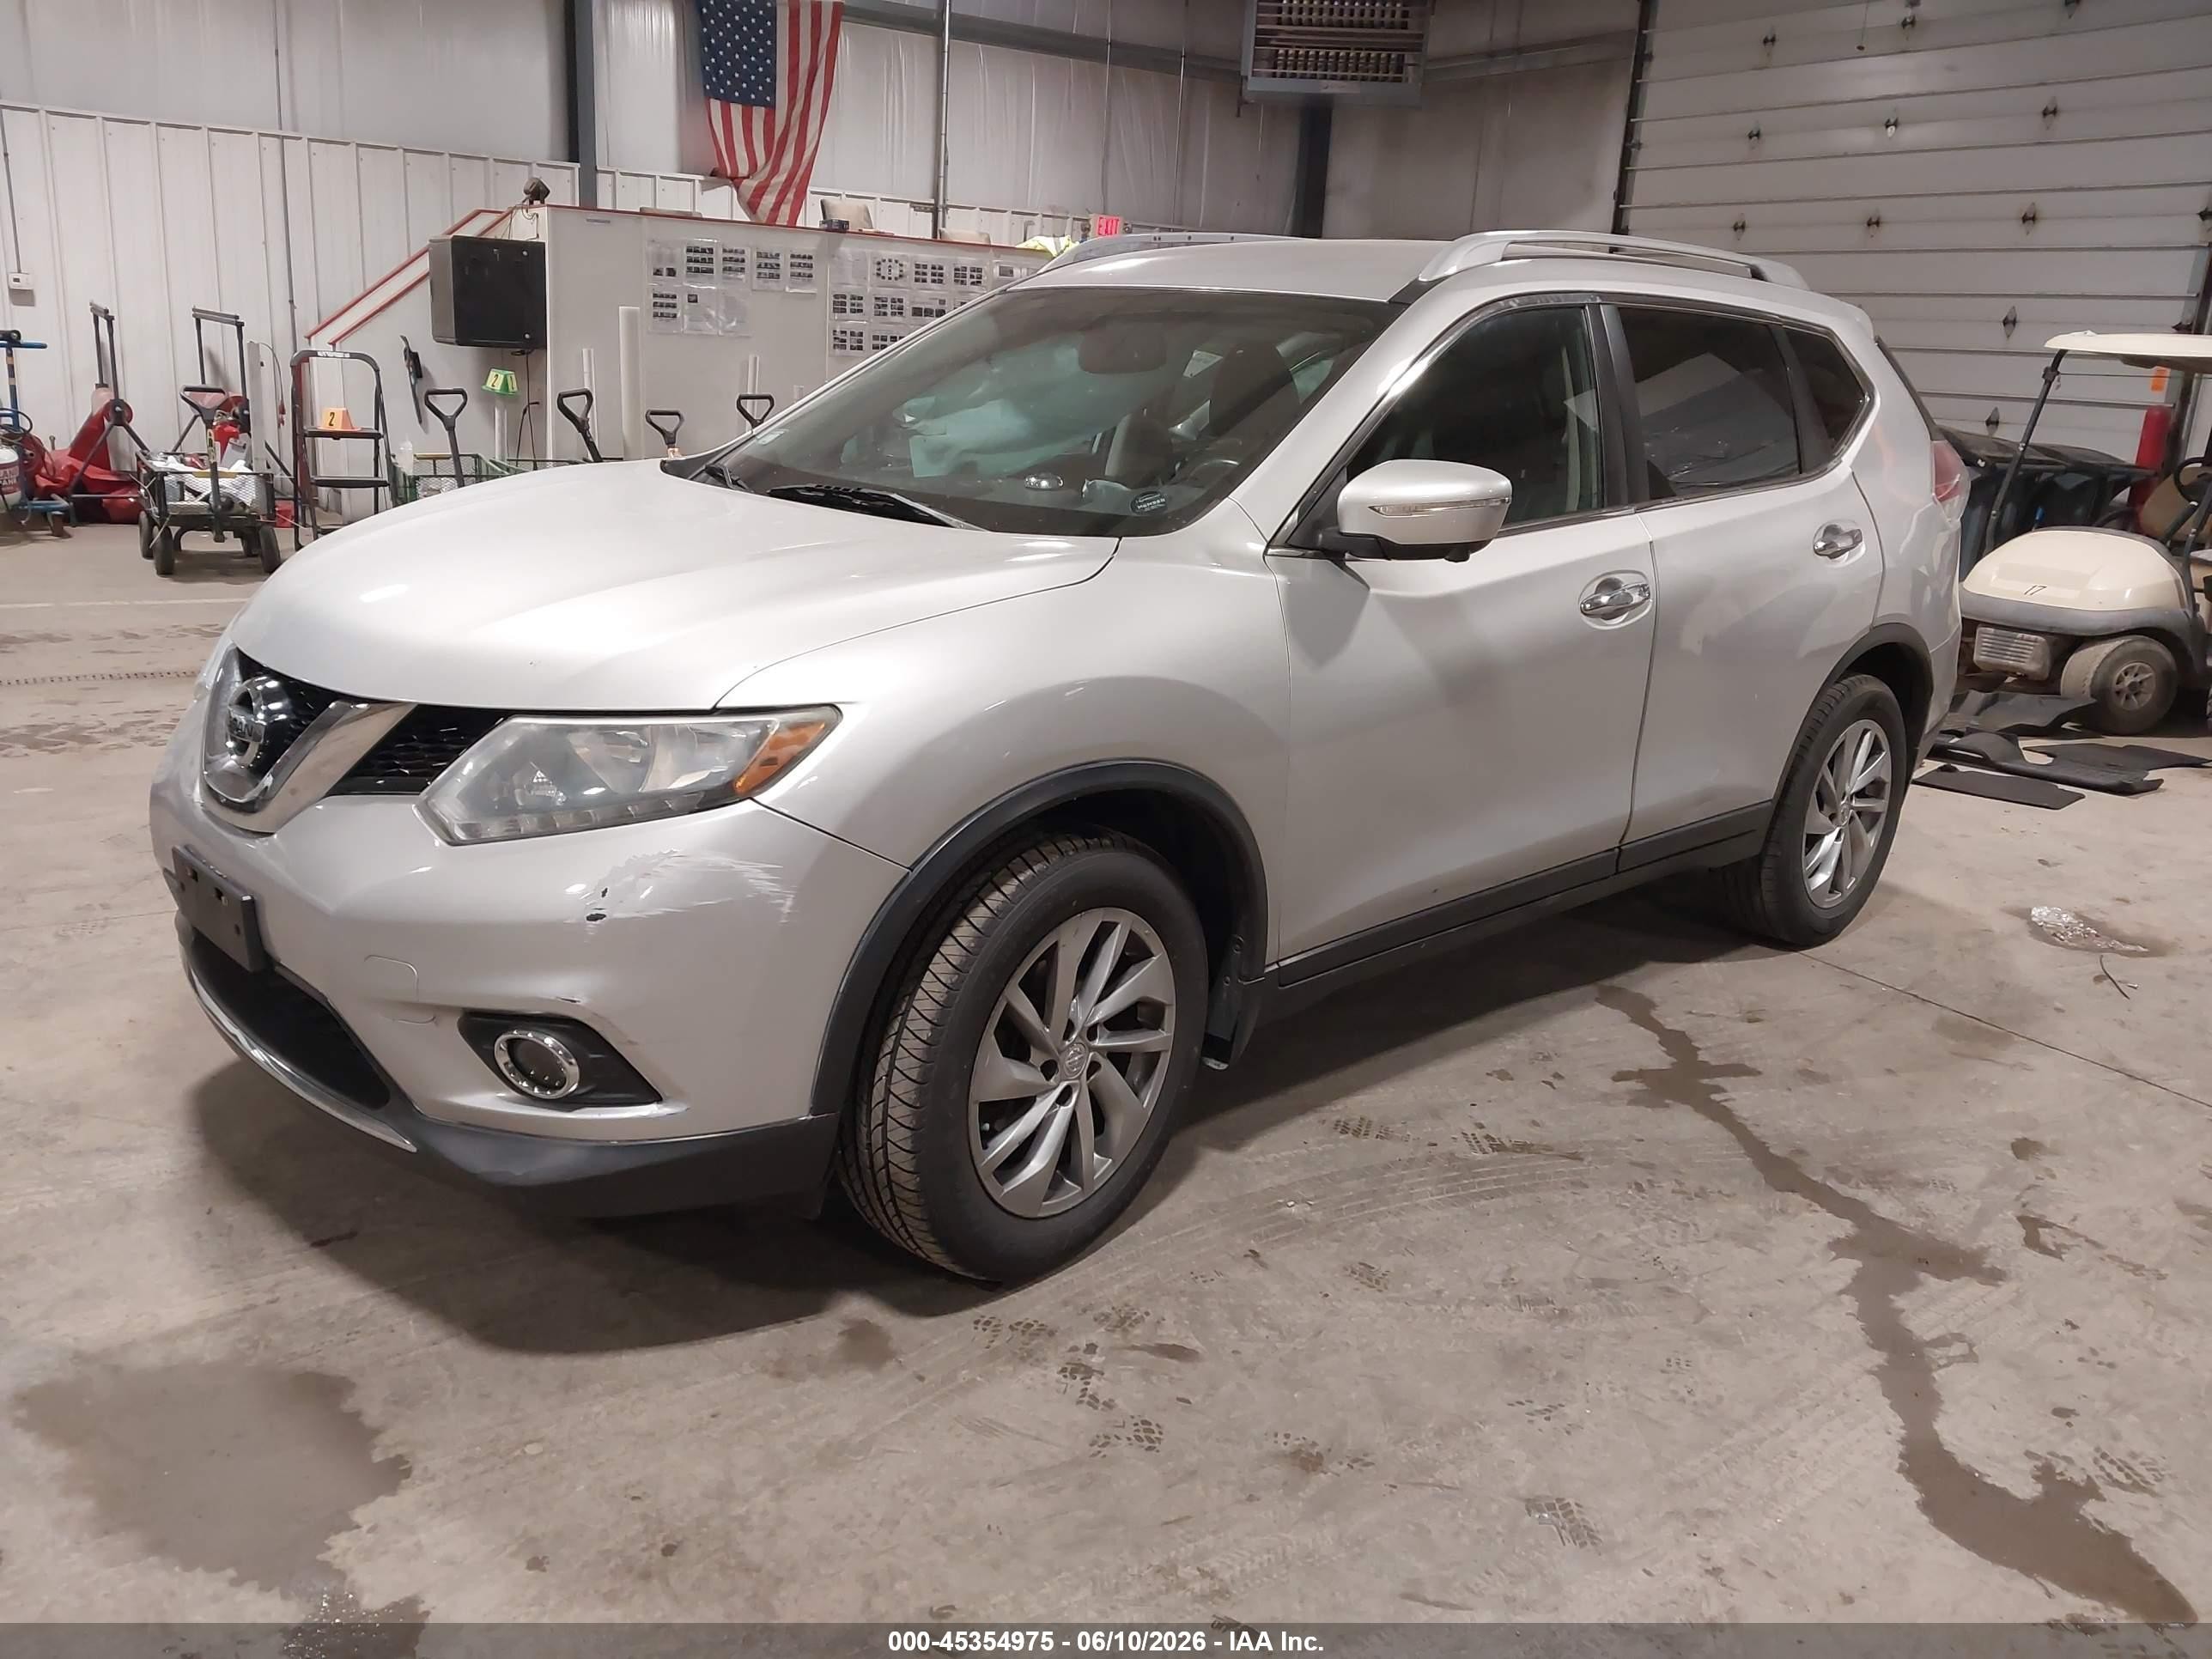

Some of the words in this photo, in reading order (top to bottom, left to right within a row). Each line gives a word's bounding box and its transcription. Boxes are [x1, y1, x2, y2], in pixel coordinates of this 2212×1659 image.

[1098, 216, 1119, 236] EXIT
[491, 374, 499, 387] 2
[328, 411, 336, 427] 2
[2024, 585, 2047, 595] 17
